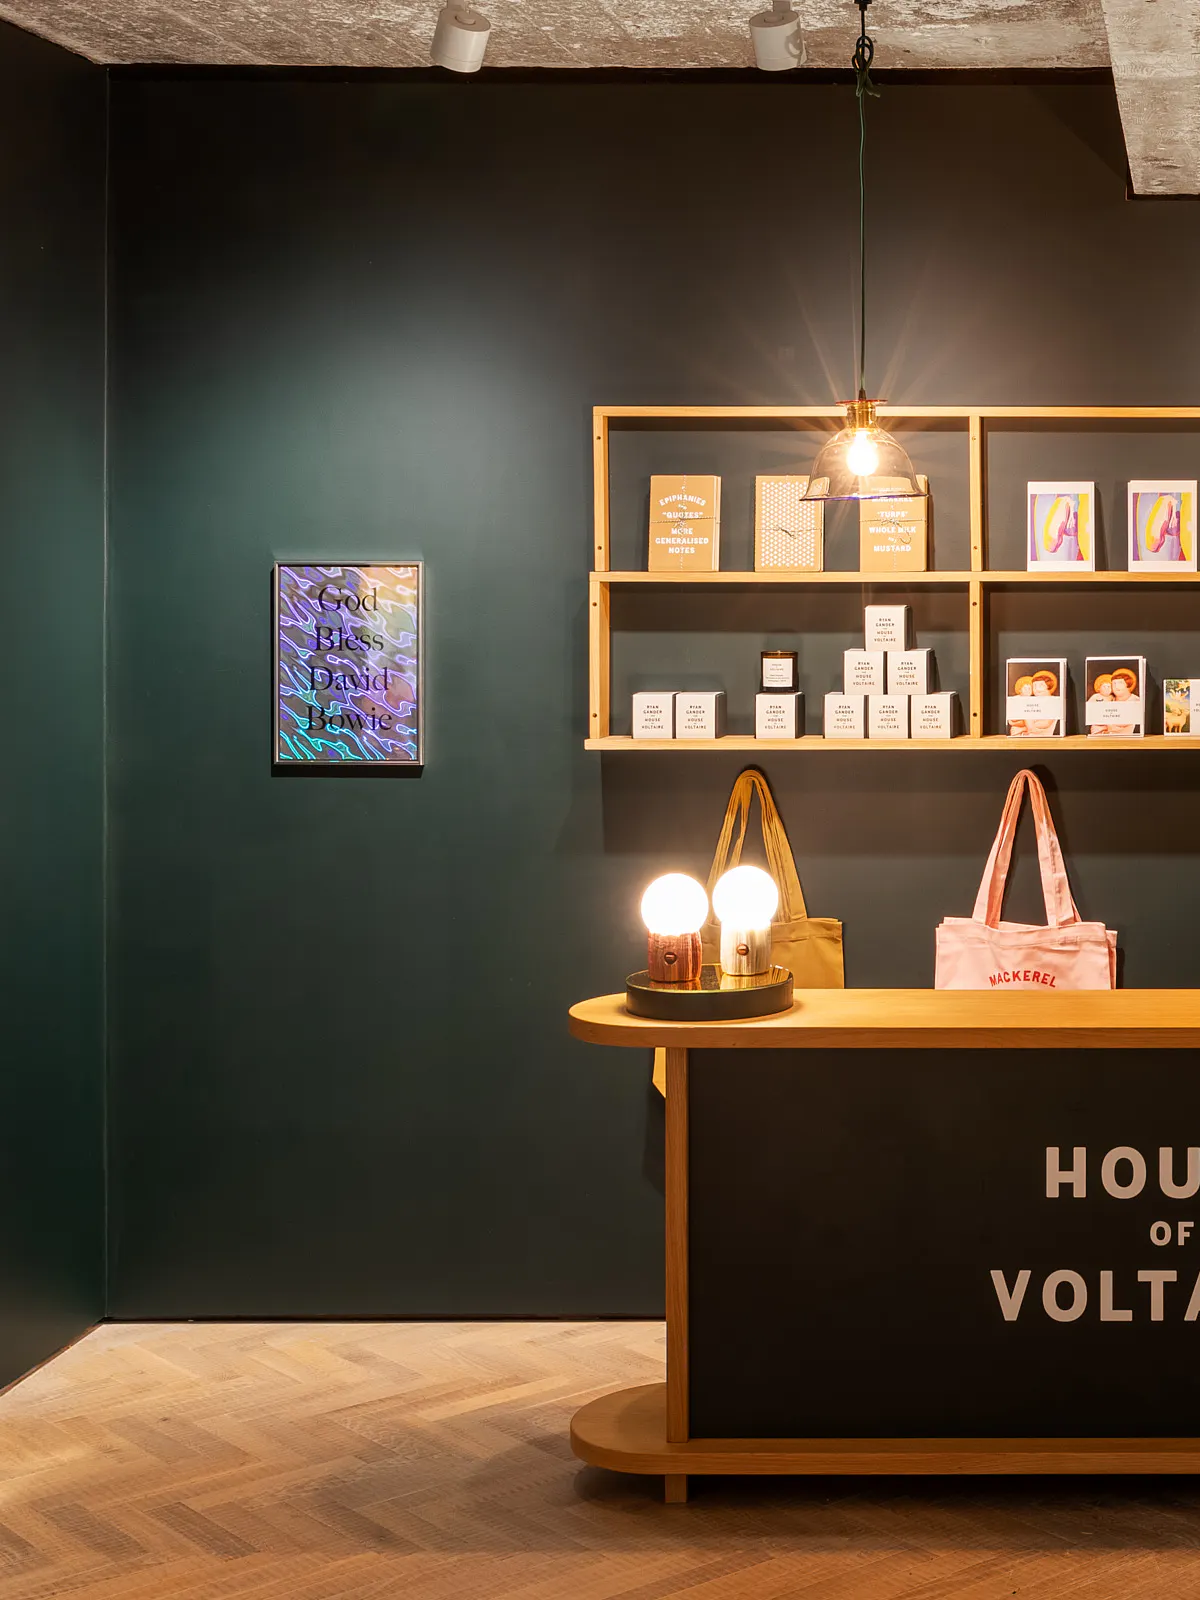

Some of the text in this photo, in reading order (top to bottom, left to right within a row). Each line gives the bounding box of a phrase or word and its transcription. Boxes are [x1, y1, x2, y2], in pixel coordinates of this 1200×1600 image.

[659, 494, 706, 506] EPIPHANIES
[318, 586, 378, 612] God
[315, 626, 384, 651] Bless
[309, 666, 389, 691] David
[306, 706, 392, 731] Bowie
[987, 970, 1057, 988] MACKEREL
[1150, 1220, 1194, 1246] OF
